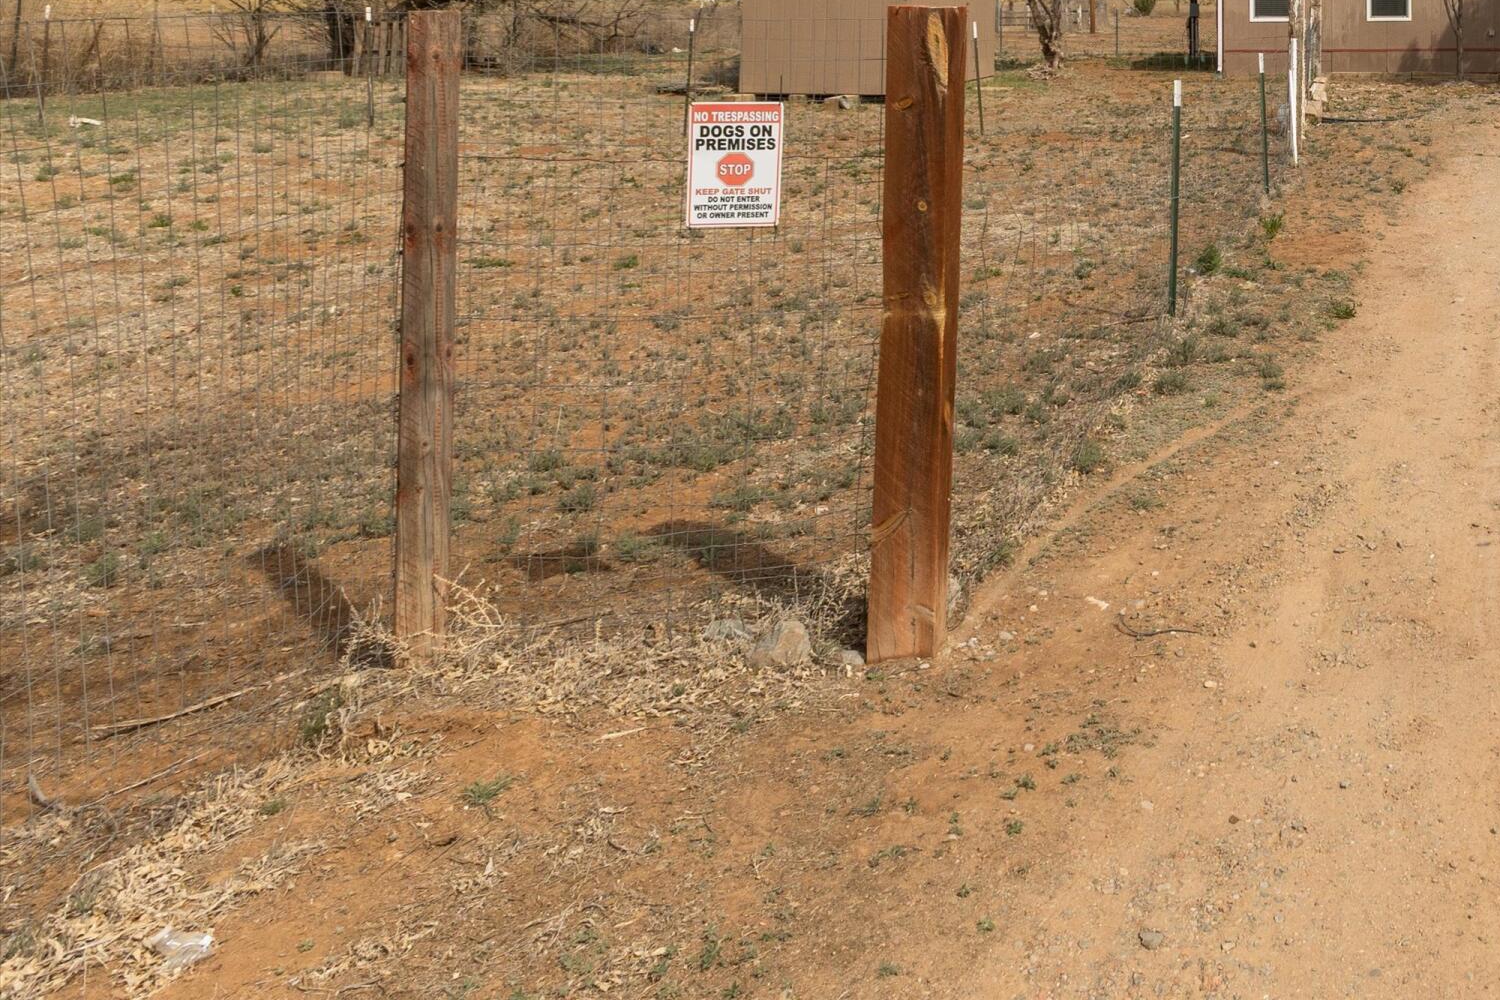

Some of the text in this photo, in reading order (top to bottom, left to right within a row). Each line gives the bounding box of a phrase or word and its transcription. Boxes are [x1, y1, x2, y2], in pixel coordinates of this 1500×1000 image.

[694, 111, 779, 122] NO TRESPASSING
[700, 125, 772, 137] DOGS ON
[695, 138, 776, 151] PREMISES
[720, 164, 751, 176] STOP
[748, 187, 772, 195] SHUT
[729, 203, 772, 211] PERMISSION
